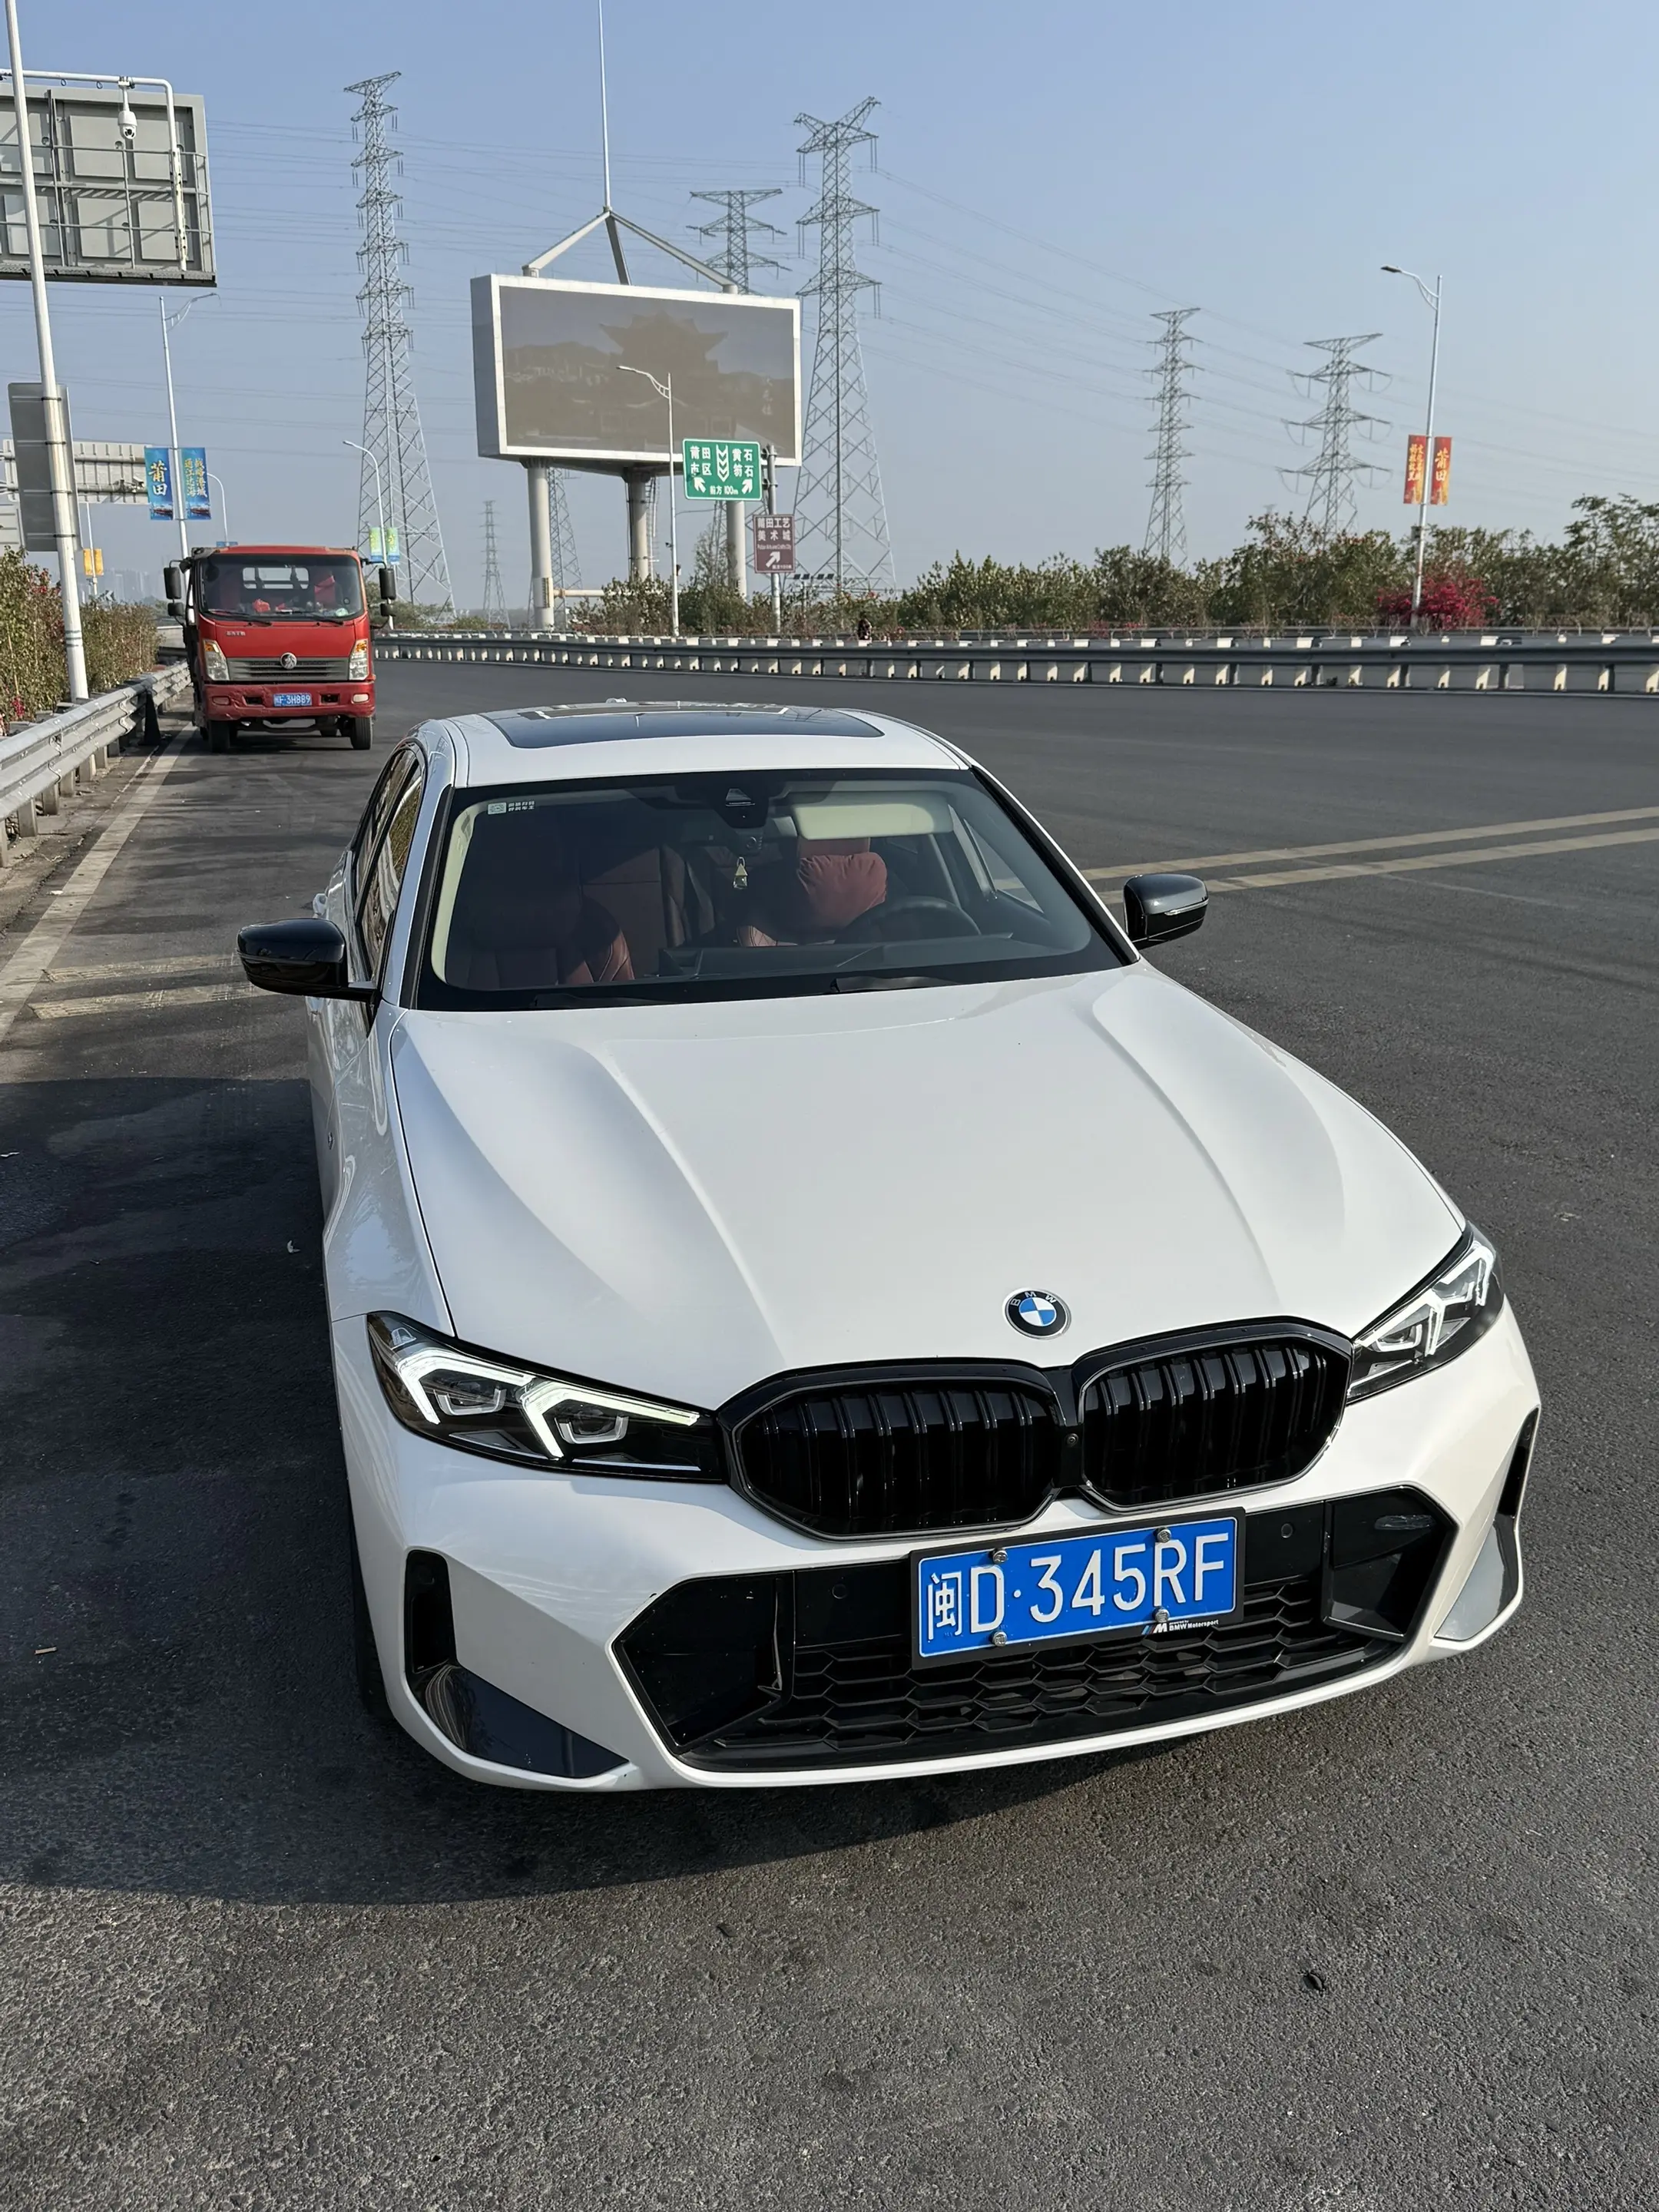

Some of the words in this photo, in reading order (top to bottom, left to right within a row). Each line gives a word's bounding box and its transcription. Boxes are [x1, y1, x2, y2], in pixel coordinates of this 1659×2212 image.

[690, 445, 710, 459] 莆田
[732, 448, 753, 462] 黄石
[690, 462, 712, 475] 市区
[1435, 447, 1449, 482] 莆田
[148, 460, 167, 496] 莆田
[757, 518, 790, 528] 莆田工艺
[1010, 1291, 1056, 1306] BMW
[927, 1532, 1230, 1641] 闽D·345RF
[1169, 1623, 1187, 1631] BMW
[1187, 1619, 1219, 1628] Motorsport
